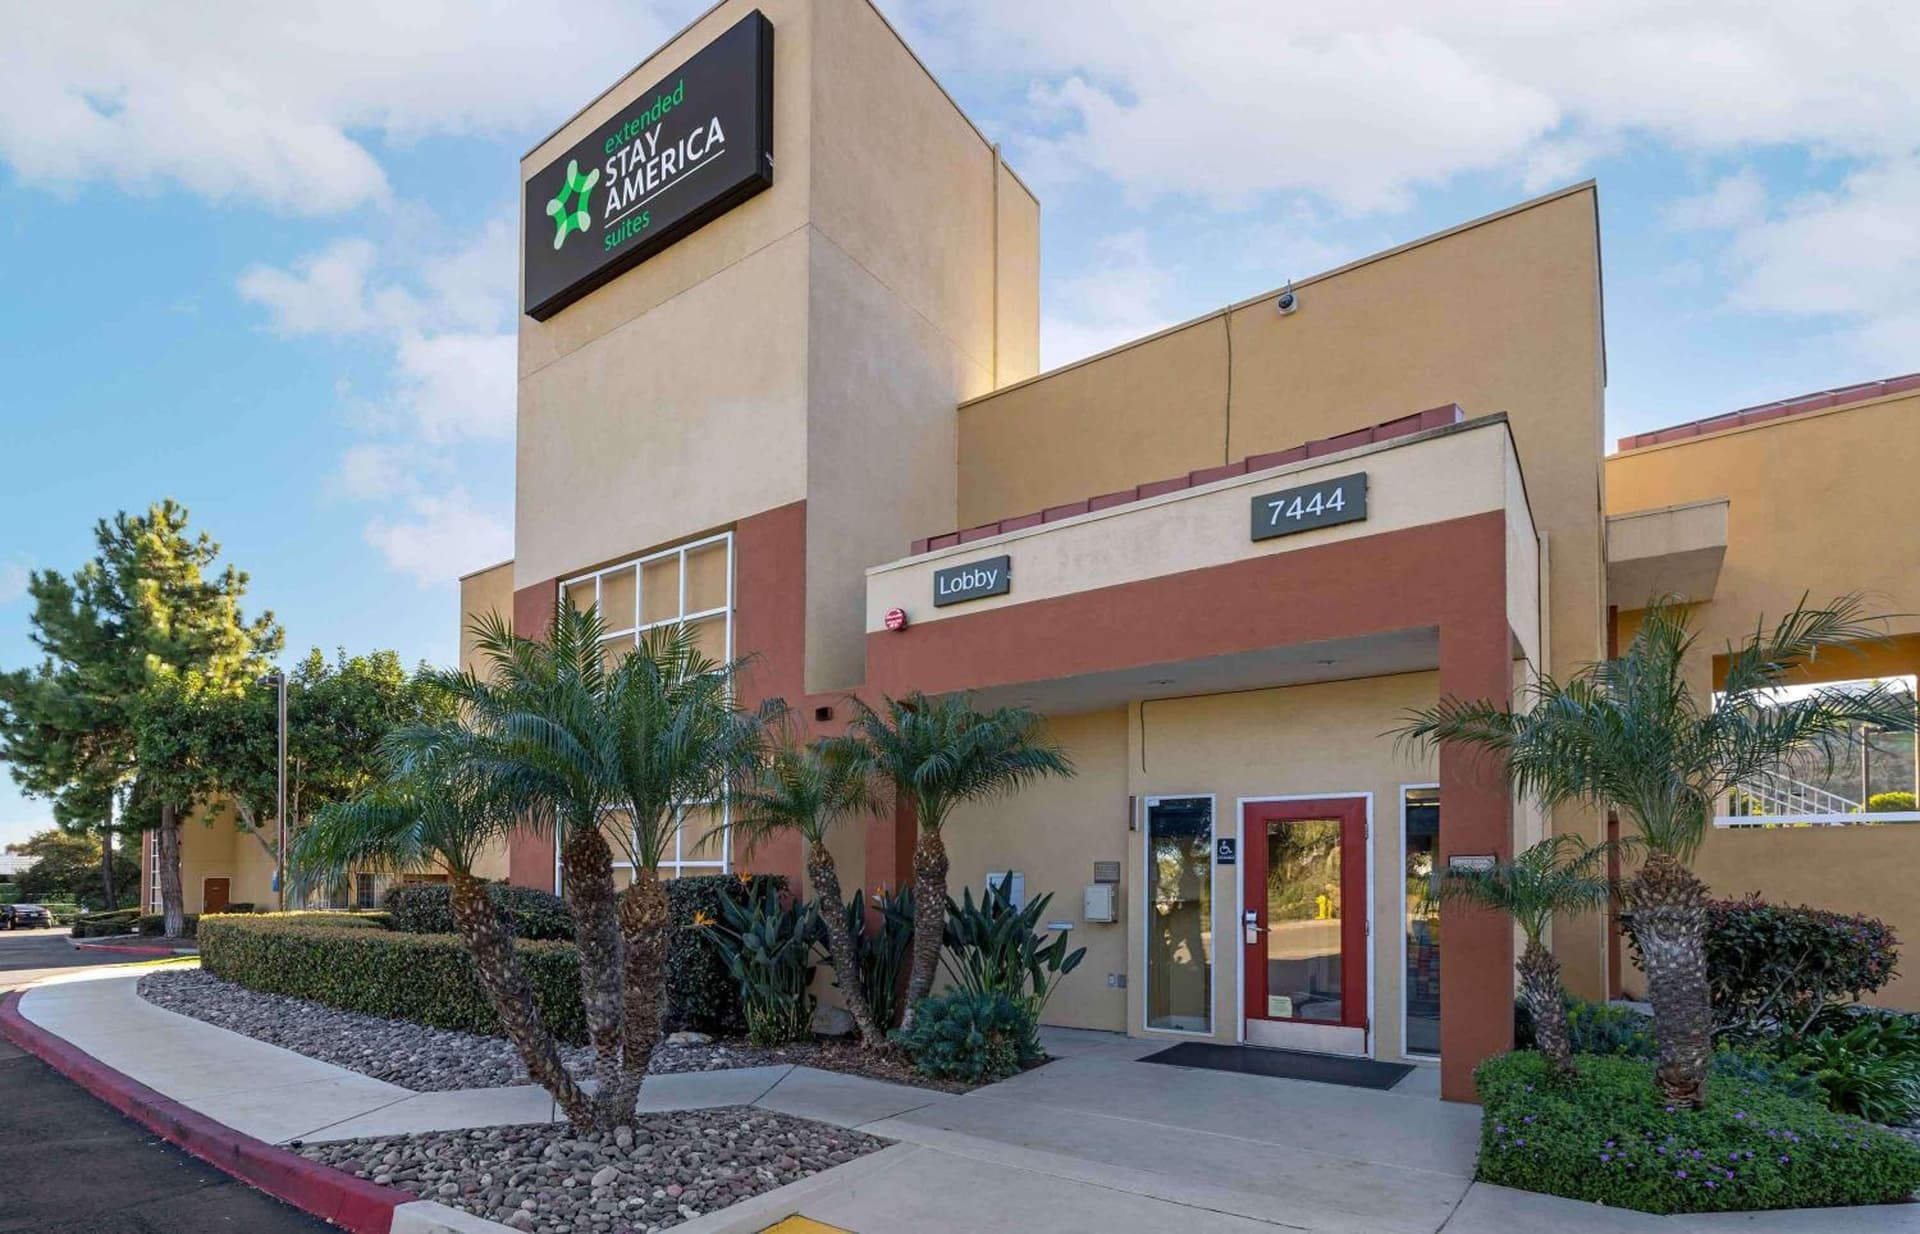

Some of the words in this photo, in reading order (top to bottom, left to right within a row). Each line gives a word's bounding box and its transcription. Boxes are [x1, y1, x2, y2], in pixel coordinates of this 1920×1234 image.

[606, 80, 685, 154] extended
[605, 123, 662, 187] STAY
[605, 116, 725, 219] AMERICA
[605, 211, 650, 251] suites
[1268, 488, 1346, 525] 7444
[940, 569, 998, 595] Lobby
